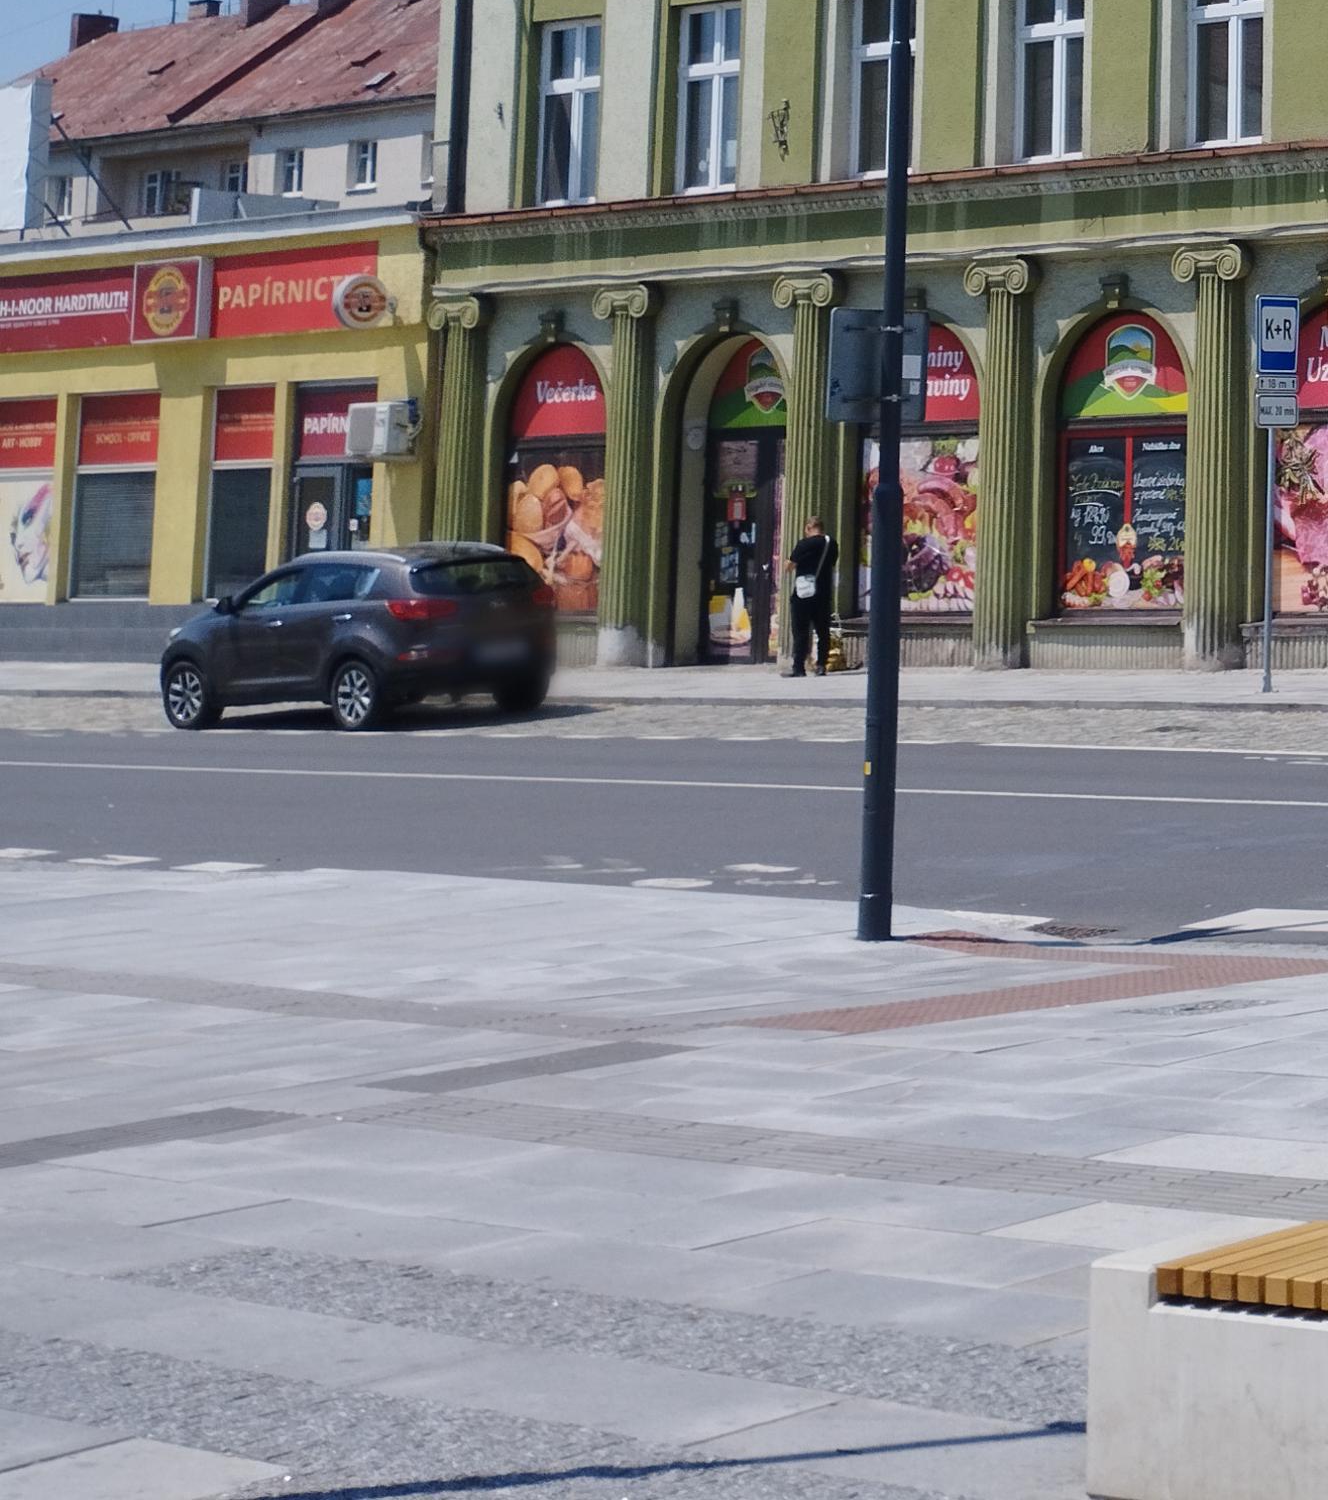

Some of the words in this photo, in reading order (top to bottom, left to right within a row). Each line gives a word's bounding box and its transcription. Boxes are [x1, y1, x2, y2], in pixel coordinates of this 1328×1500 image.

[54, 290, 128, 312] HARDTMUTH
[218, 267, 371, 310] PAPÍRNICT
[1265, 318, 1292, 340] K+R
[927, 345, 963, 372] niny
[536, 379, 597, 404] Večerka
[927, 374, 971, 401] aviny
[303, 413, 350, 434] PAPÍRN
